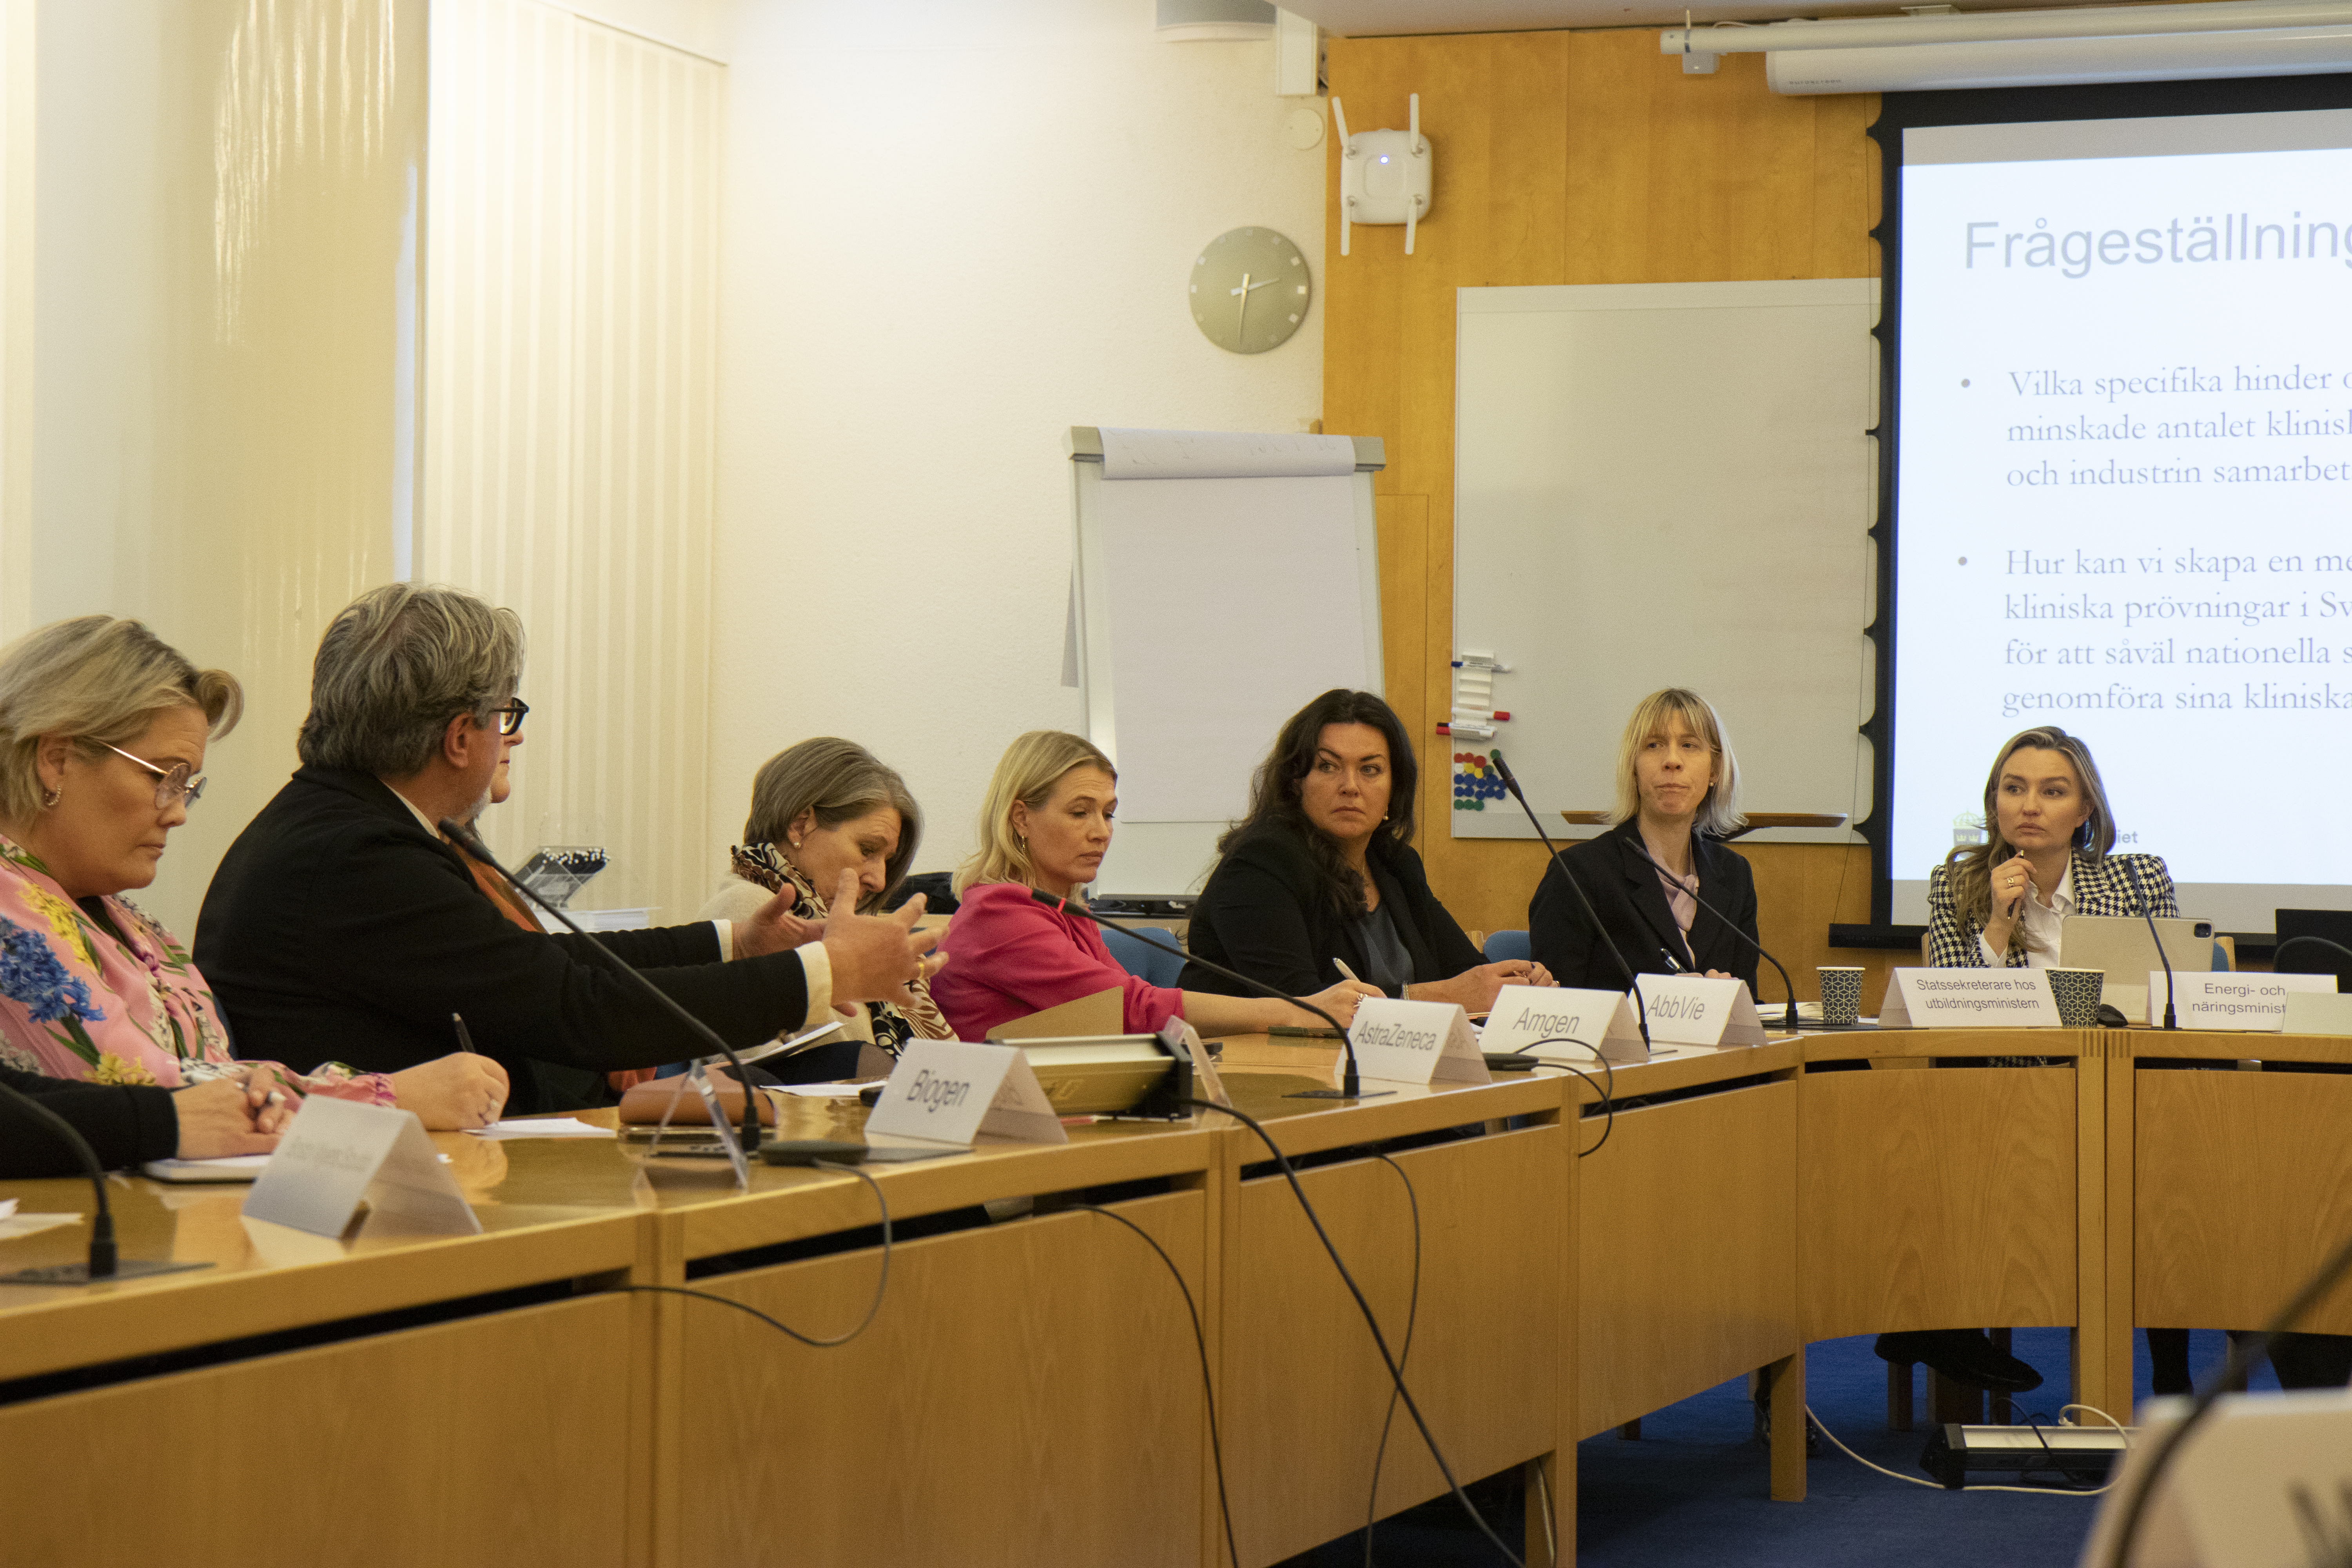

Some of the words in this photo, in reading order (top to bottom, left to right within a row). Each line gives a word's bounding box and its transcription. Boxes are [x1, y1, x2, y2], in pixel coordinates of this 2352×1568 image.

[1966, 211, 2352, 279] Frågeställnin
[2009, 370, 2082, 395] Vilka
[2095, 367, 2222, 403] specifika
[2235, 364, 2332, 390] hinder
[2008, 414, 2146, 441] minskade
[2158, 412, 2255, 439] antalet
[2007, 460, 2058, 486] och
[2071, 457, 2201, 485] industrin
[2214, 455, 2352, 483] samarbet
[2005, 550, 2065, 575] Hur
[2076, 549, 2127, 574] kan
[2138, 548, 2162, 573] vi
[2175, 548, 2256, 581] skapa
[2269, 556, 2303, 572] en
[2005, 593, 2113, 619] kliniska
[2125, 592, 2290, 627] prövningar
[2300, 591, 2309, 617] i
[2320, 592, 2352, 617] Sv
[2006, 639, 2047, 664] för
[2058, 646, 2094, 664] att
[2105, 638, 2174, 664] såväl
[2186, 637, 2330, 664] nationella
[2002, 682, 2163, 717] genomföra
[2176, 683, 2232, 709] sina
[2245, 682, 2352, 709] kliniska
[2116, 829, 2138, 844] iet
[1916, 979, 2012, 990] Statssekreterare
[2014, 979, 2036, 990] hos
[2205, 983, 2255, 998] Energi-
[2260, 985, 2285, 996] och
[1646, 995, 1705, 1020] AbbVie
[1926, 998, 2040, 1012] utbildningsministern
[2192, 1002, 2286, 1016] näringsminist
[1354, 1021, 1437, 1051] AstraZeneca
[1512, 1007, 1580, 1038] Amgen
[906, 1069, 970, 1114] Biogen
